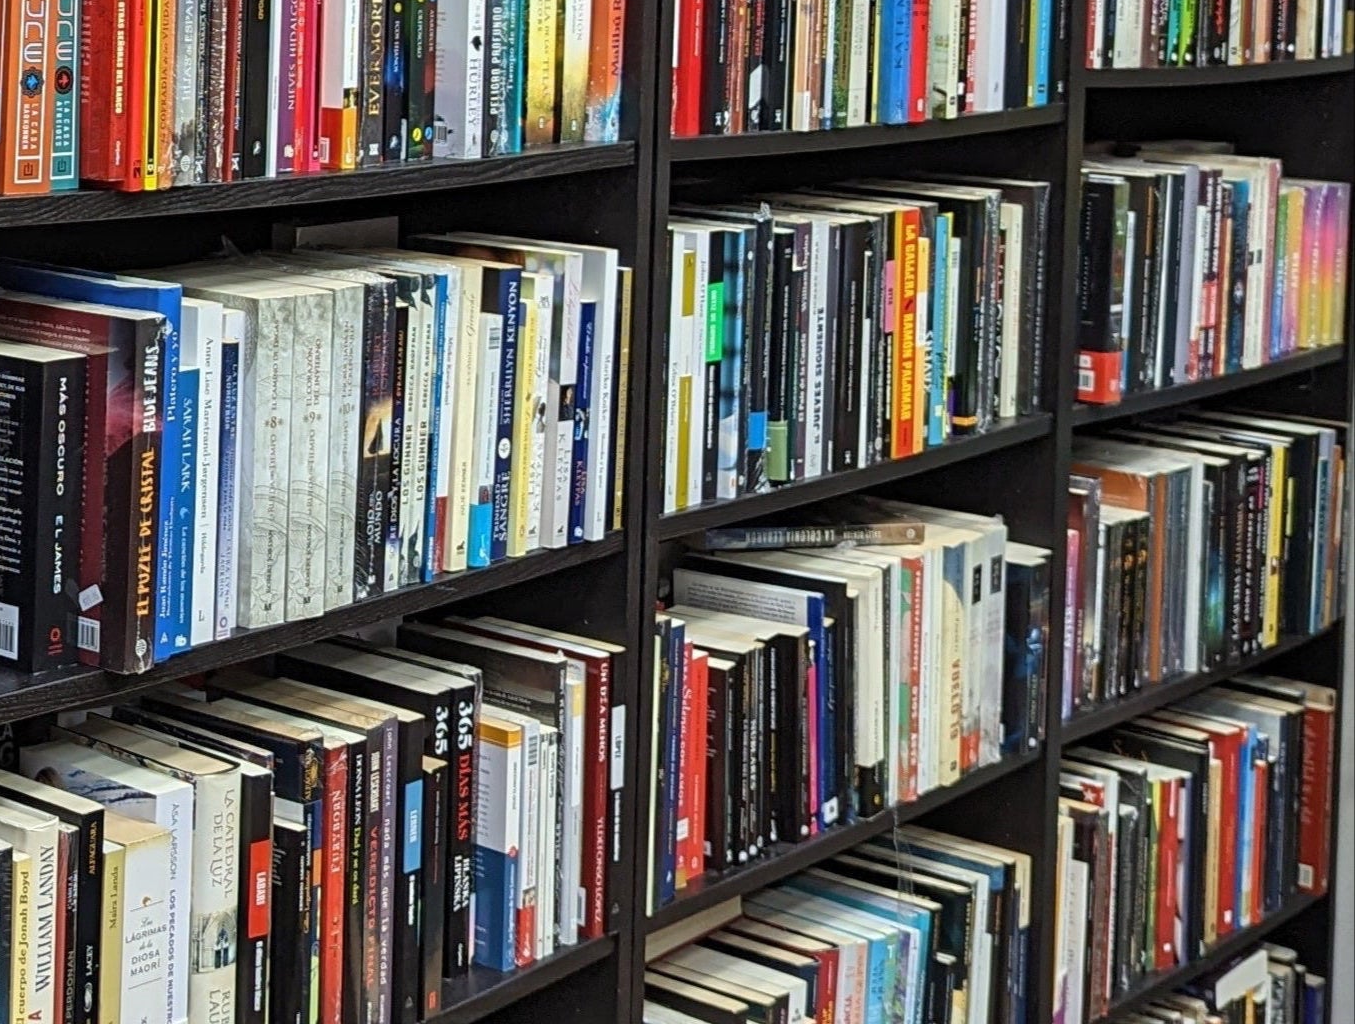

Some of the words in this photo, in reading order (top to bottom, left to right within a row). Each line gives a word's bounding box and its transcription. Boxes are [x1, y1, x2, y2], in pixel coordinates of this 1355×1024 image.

[506, 281, 517, 343] KENYON
[814, 307, 824, 377] SIGUIENTE
[56, 376, 67, 415] MÁS
[502, 347, 516, 425] SHERRILYN
[900, 360, 913, 421] PALOMAR
[182, 397, 193, 447] SARAH
[55, 420, 66, 497] OSCURO
[141, 448, 156, 514] CRISTAL
[180, 452, 191, 492] LARK
[599, 663, 609, 685] UN
[435, 706, 449, 754] 365
[458, 700, 474, 750] 365
[223, 789, 234, 807] LA
[457, 753, 471, 800] DÍAS
[213, 814, 223, 835] DE
[457, 804, 470, 841] MÁS
[37, 846, 54, 907] LANDAY
[212, 862, 222, 888] LUZ
[224, 813, 236, 899] CATEDRAL
[34, 912, 53, 993] WILLIAM
